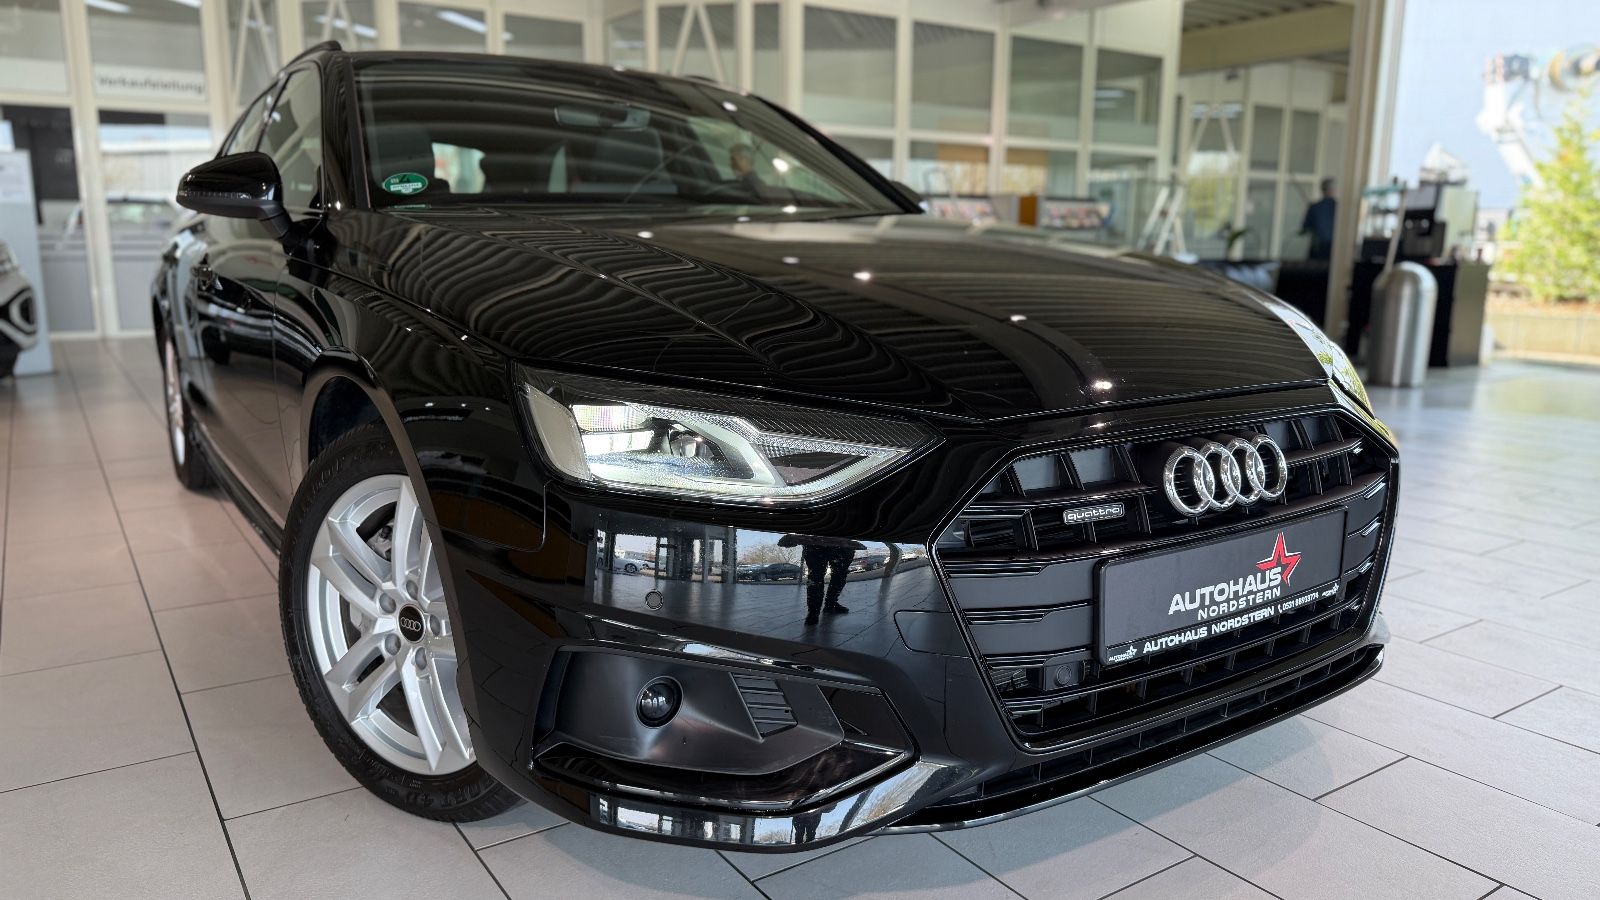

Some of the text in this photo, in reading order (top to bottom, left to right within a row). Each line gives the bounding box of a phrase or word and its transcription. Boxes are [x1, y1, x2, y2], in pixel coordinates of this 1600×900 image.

[1067, 507, 1120, 521] quattro
[1168, 566, 1282, 615] AUTOHAUS
[1197, 586, 1281, 621] NORDSTERN
[1142, 626, 1208, 653] AUTOHAUS
[1211, 605, 1275, 635] NORDSTERN
